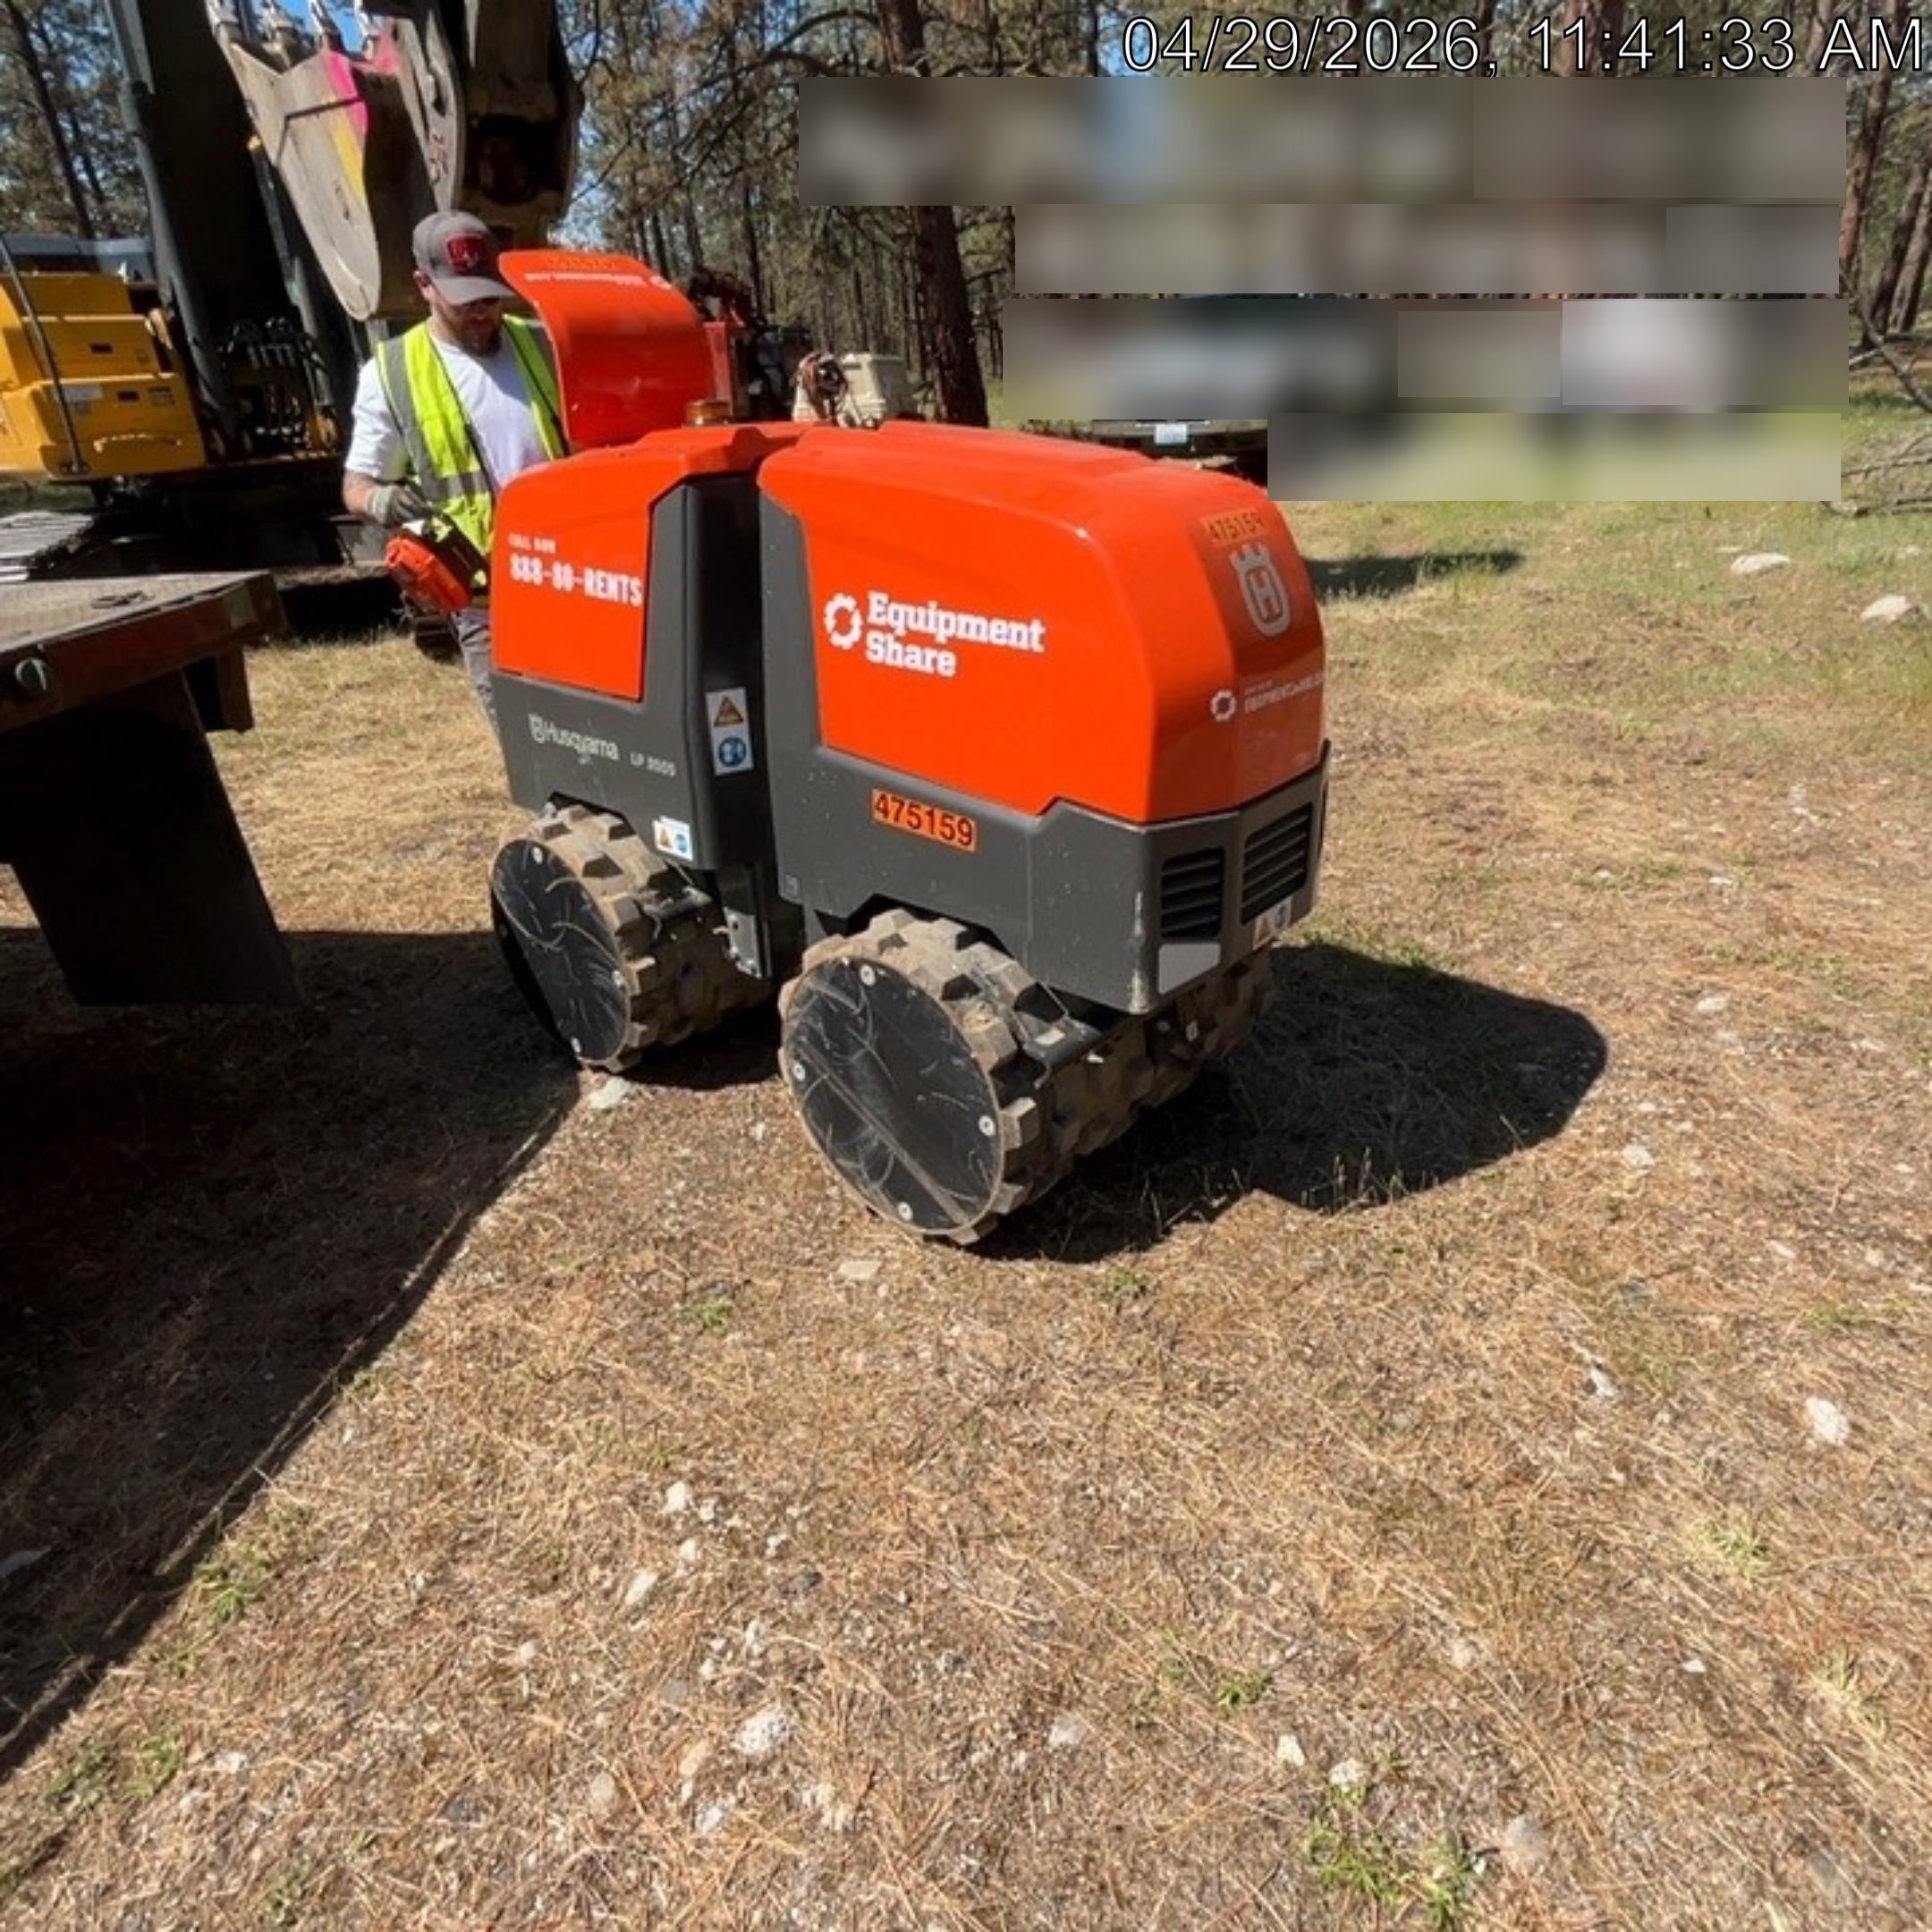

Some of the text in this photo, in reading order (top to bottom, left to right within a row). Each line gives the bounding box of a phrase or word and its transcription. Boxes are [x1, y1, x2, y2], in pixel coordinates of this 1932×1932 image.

[867, 590, 1046, 653] Equipment
[865, 630, 957, 677] Share
[544, 721, 619, 760] Husqvarna
[875, 793, 973, 846] 475159
